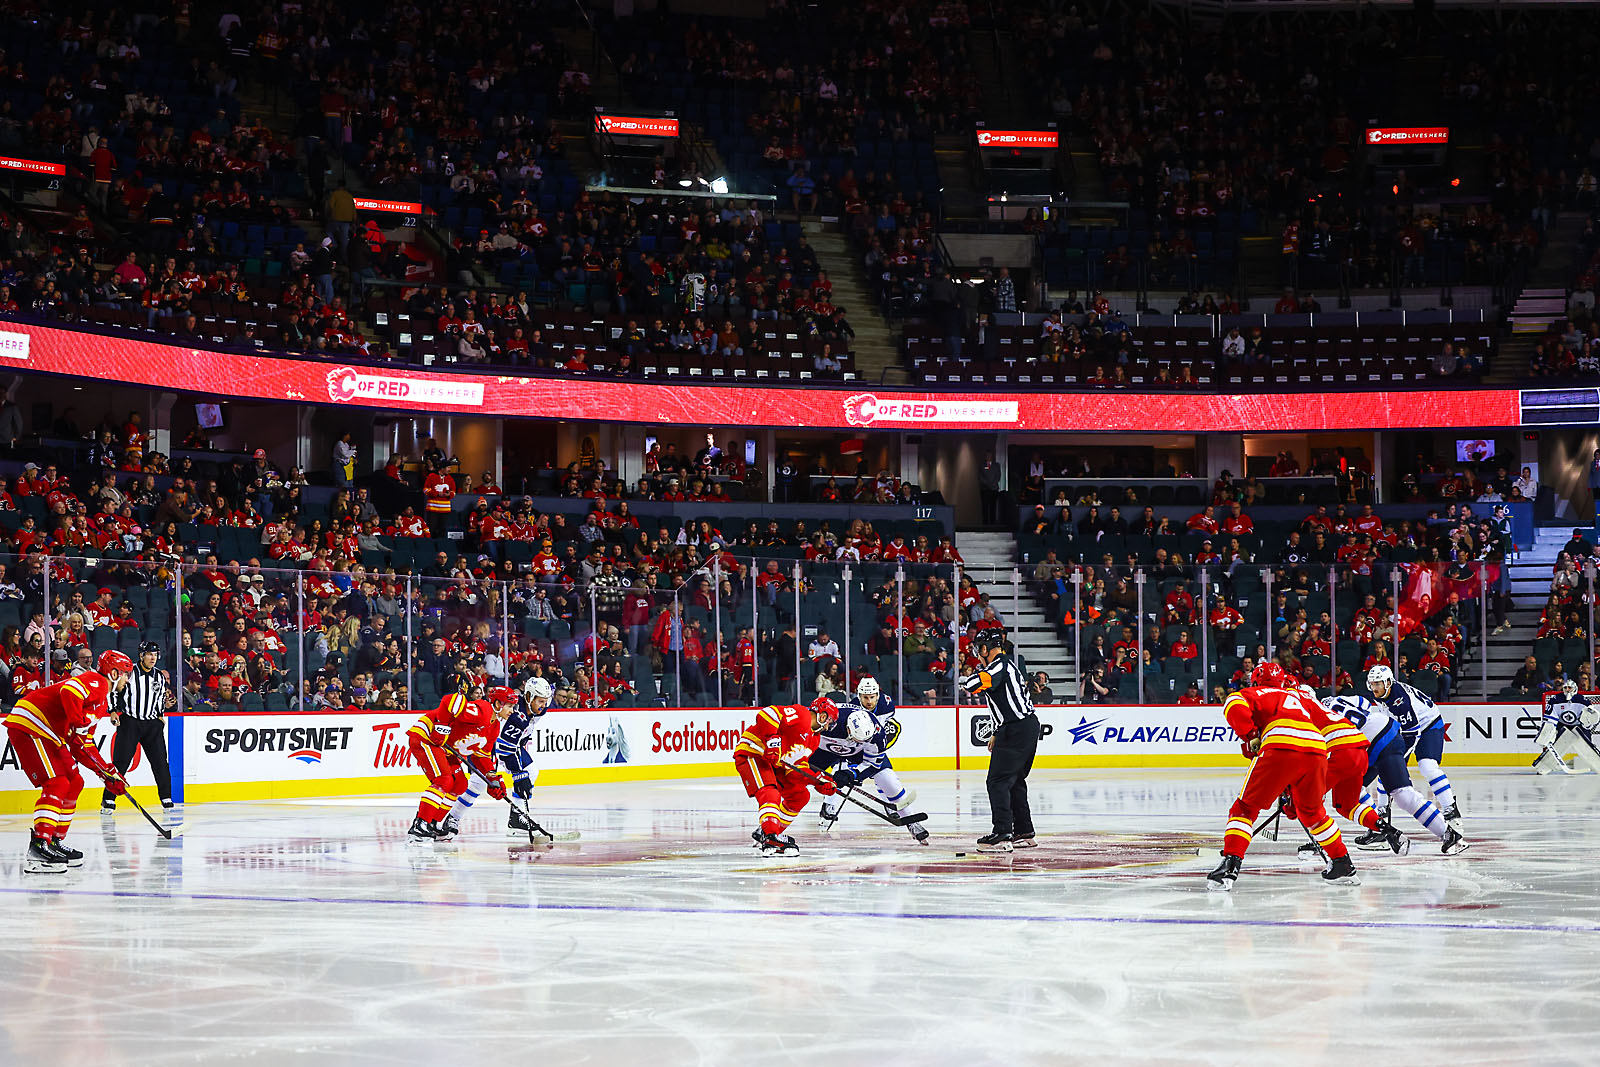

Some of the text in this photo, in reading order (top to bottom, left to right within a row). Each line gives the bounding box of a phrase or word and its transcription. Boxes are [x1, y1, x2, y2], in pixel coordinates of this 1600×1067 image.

[48, 180, 60, 190] 23
[402, 216, 416, 227] 22
[358, 381, 374, 392] OF
[378, 381, 410, 396] RED
[412, 387, 444, 396] LIVES
[878, 406, 898, 416] OF
[901, 404, 938, 418] RED
[942, 408, 976, 416] LIVES
[916, 508, 932, 518] 117
[466, 702, 478, 716] 17
[1282, 694, 1310, 720] 4
[784, 707, 798, 722] 91
[1401, 711, 1412, 725] 54
[504, 724, 521, 738] 22
[205, 727, 353, 753] SPORTSNET
[372, 723, 412, 768] Tim
[536, 728, 604, 752] LitcoLaw
